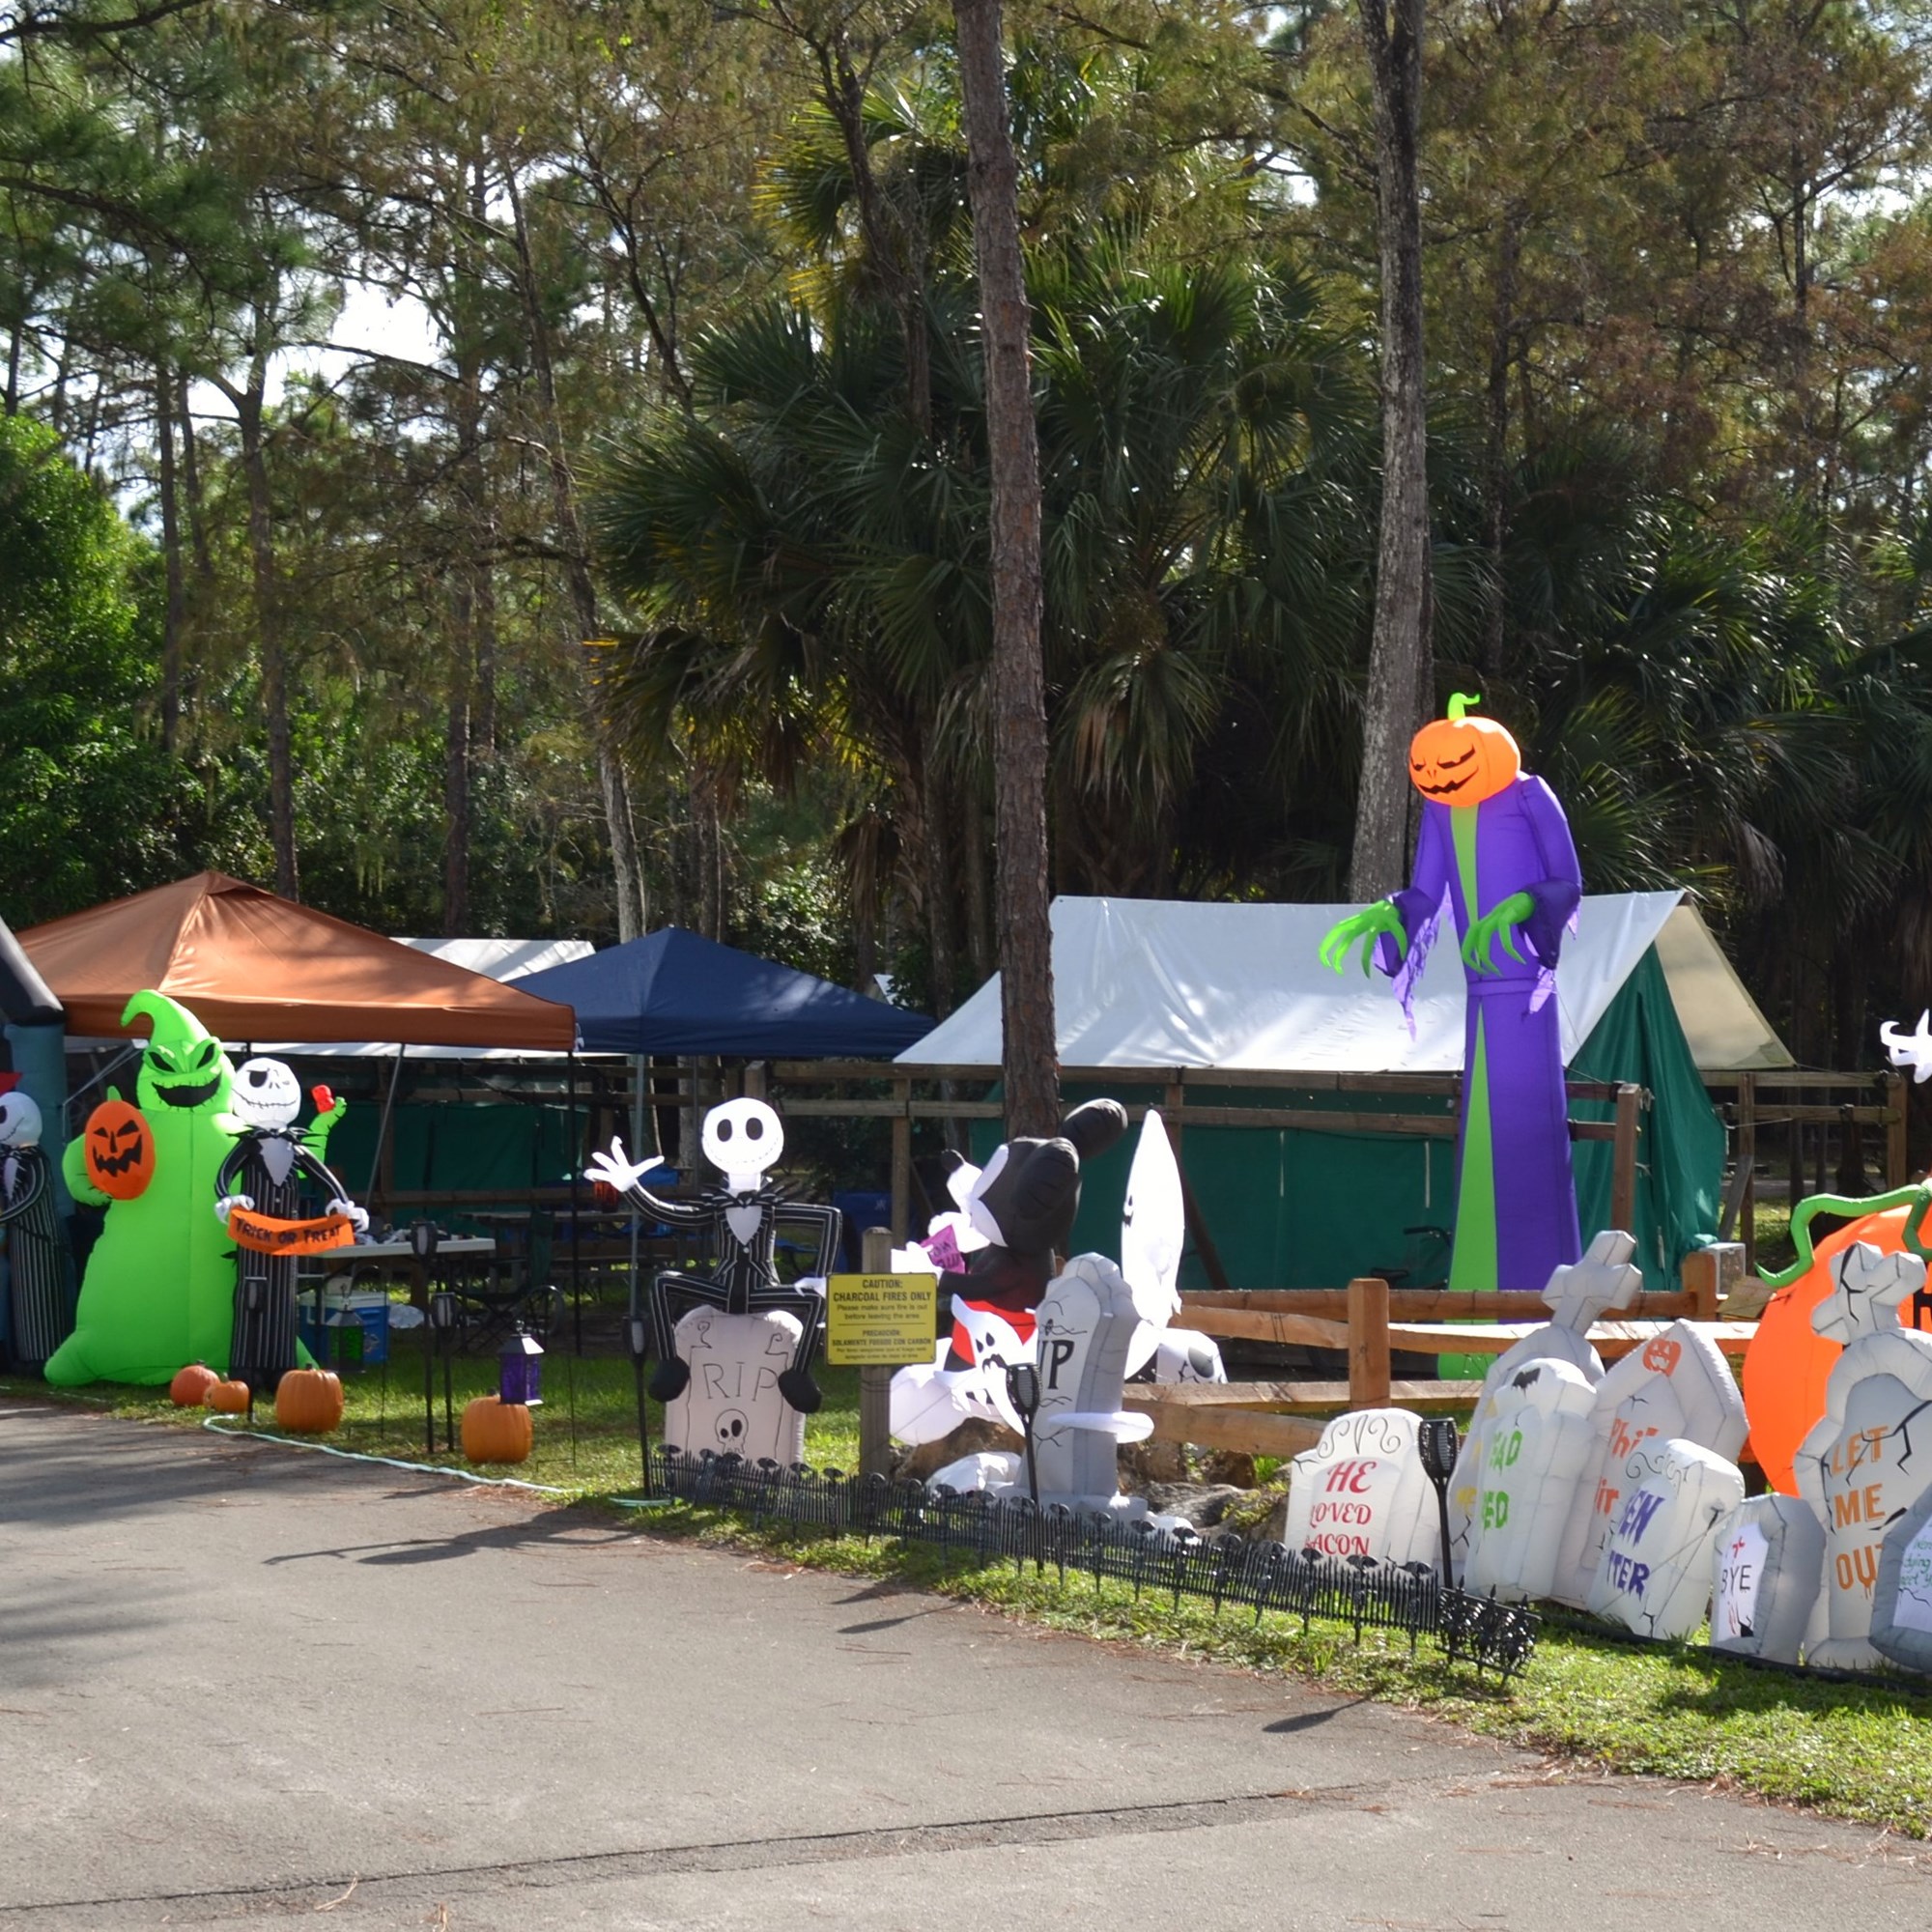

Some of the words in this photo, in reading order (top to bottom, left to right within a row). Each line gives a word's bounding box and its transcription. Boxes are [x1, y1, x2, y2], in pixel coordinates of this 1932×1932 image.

[236, 1217, 271, 1242] TRICK
[277, 1231, 298, 1245] OR
[303, 1224, 341, 1243] TREAT
[833, 1292, 880, 1302] CHARCOAL
[883, 1292, 907, 1301] FIRES
[910, 1292, 931, 1301] ONLY
[862, 1279, 903, 1289] CAUTION:
[1038, 1339, 1075, 1390] IP
[702, 1361, 779, 1402] RIP
[1832, 1425, 1889, 1476] LET
[1325, 1460, 1378, 1493] HE
[1834, 1483, 1886, 1529] ME
[1720, 1564, 1753, 1597] BYE
